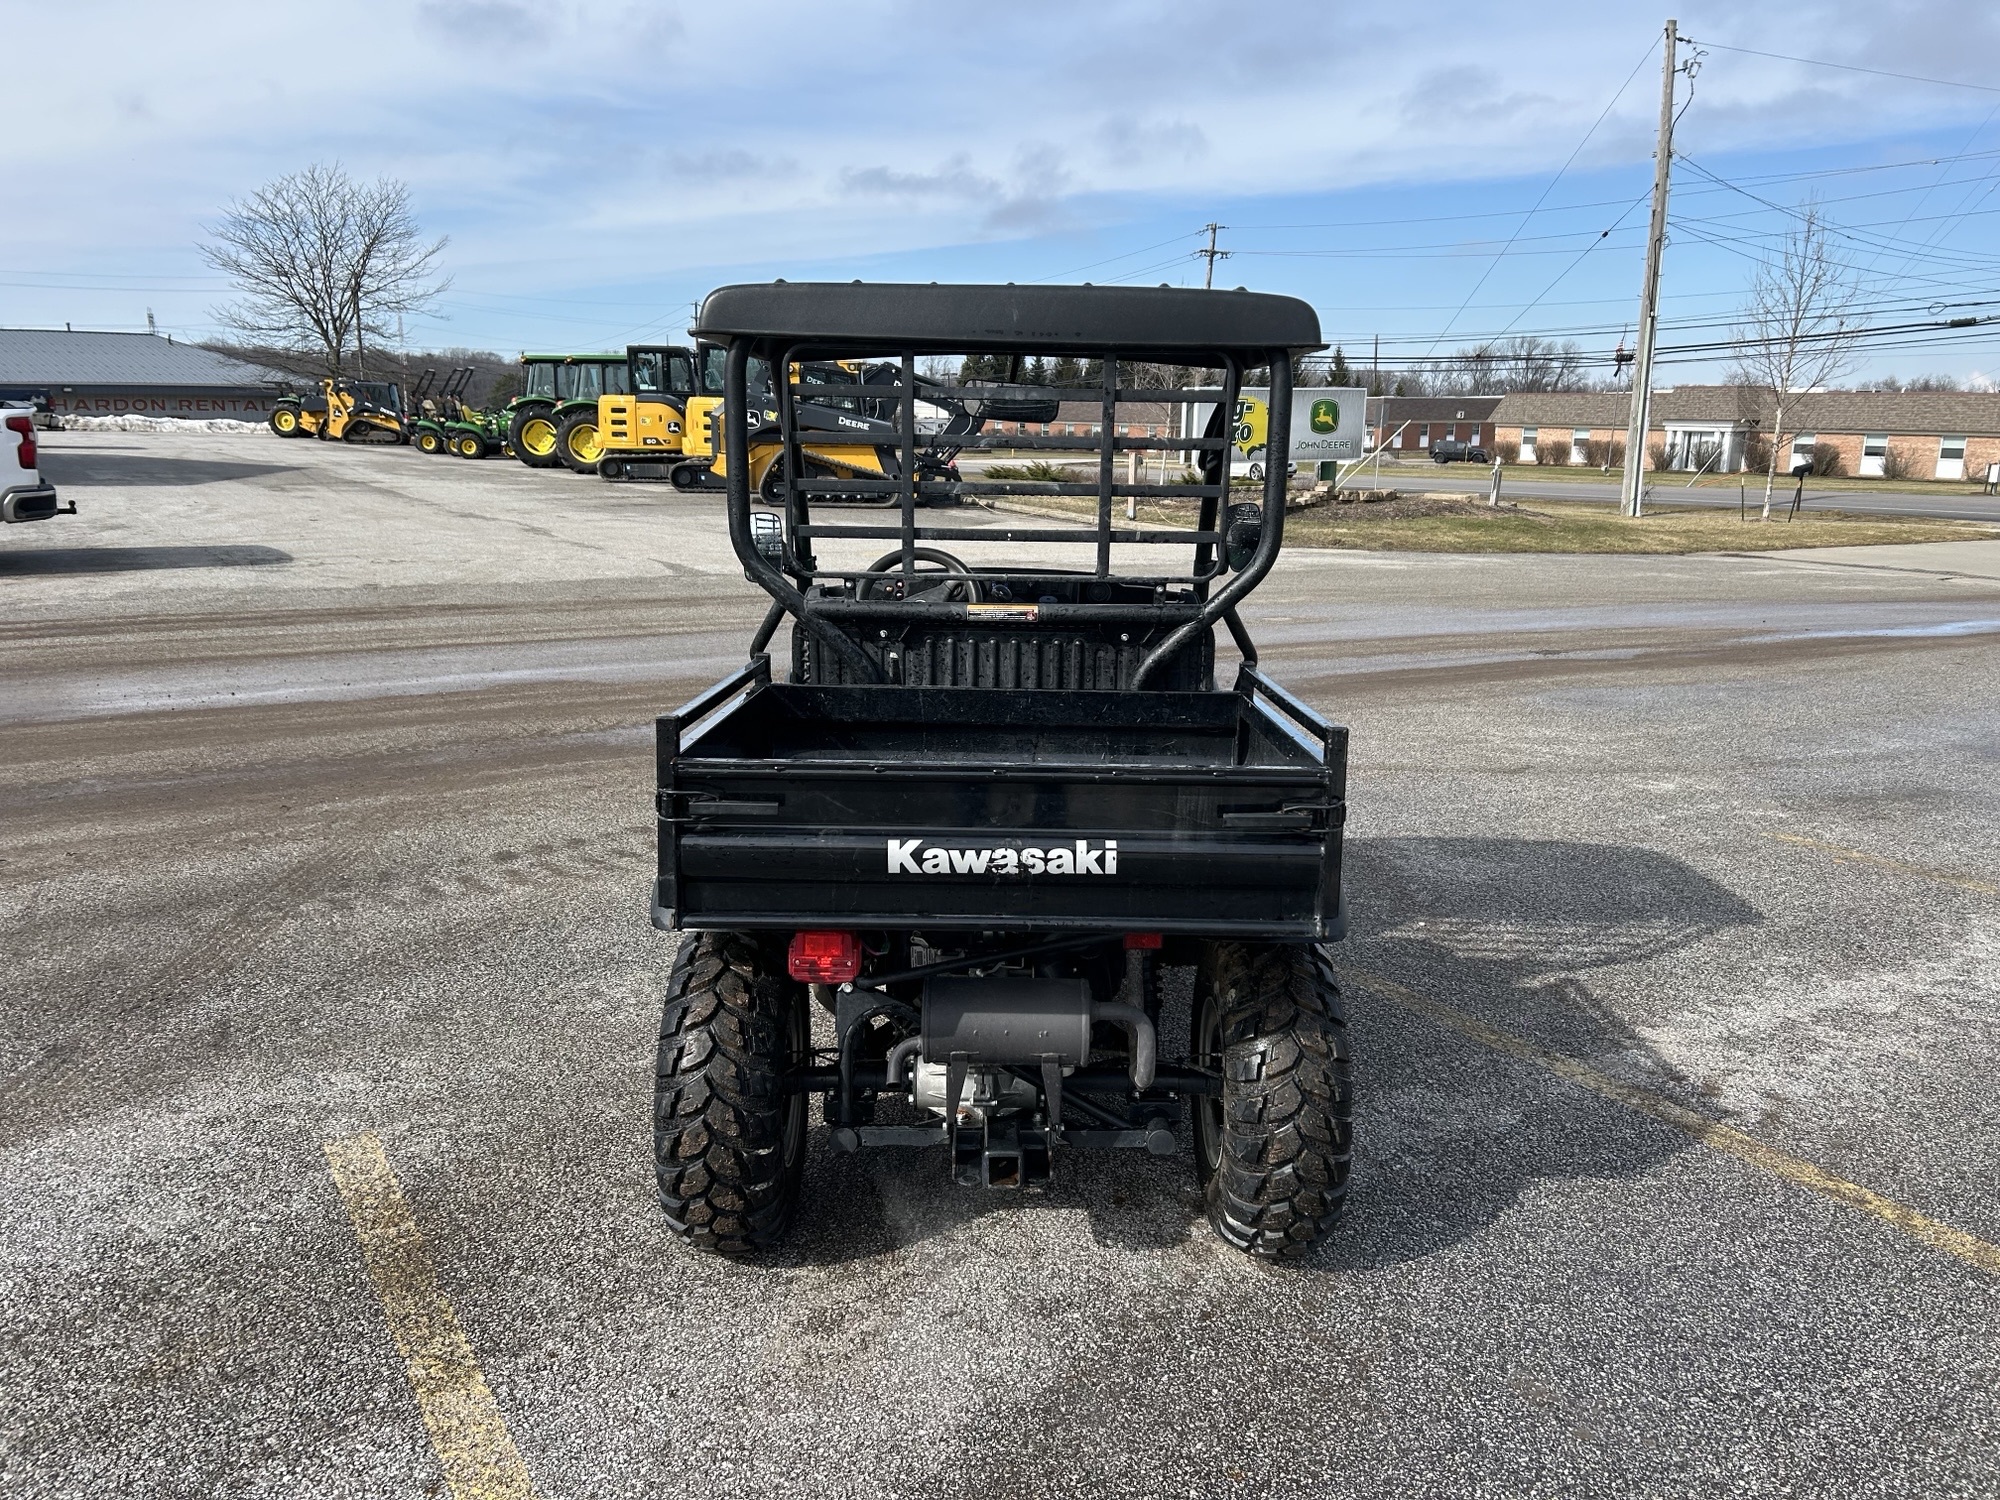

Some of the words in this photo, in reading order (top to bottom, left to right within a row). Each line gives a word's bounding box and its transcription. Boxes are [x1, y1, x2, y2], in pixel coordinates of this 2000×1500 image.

[806, 375, 821, 385] DEE
[178, 399, 272, 412] RENTAL
[838, 416, 870, 431] DEERE
[1295, 439, 1320, 450] JOHN
[1321, 439, 1351, 449] DEERE
[887, 839, 1118, 875] Kawasaki
